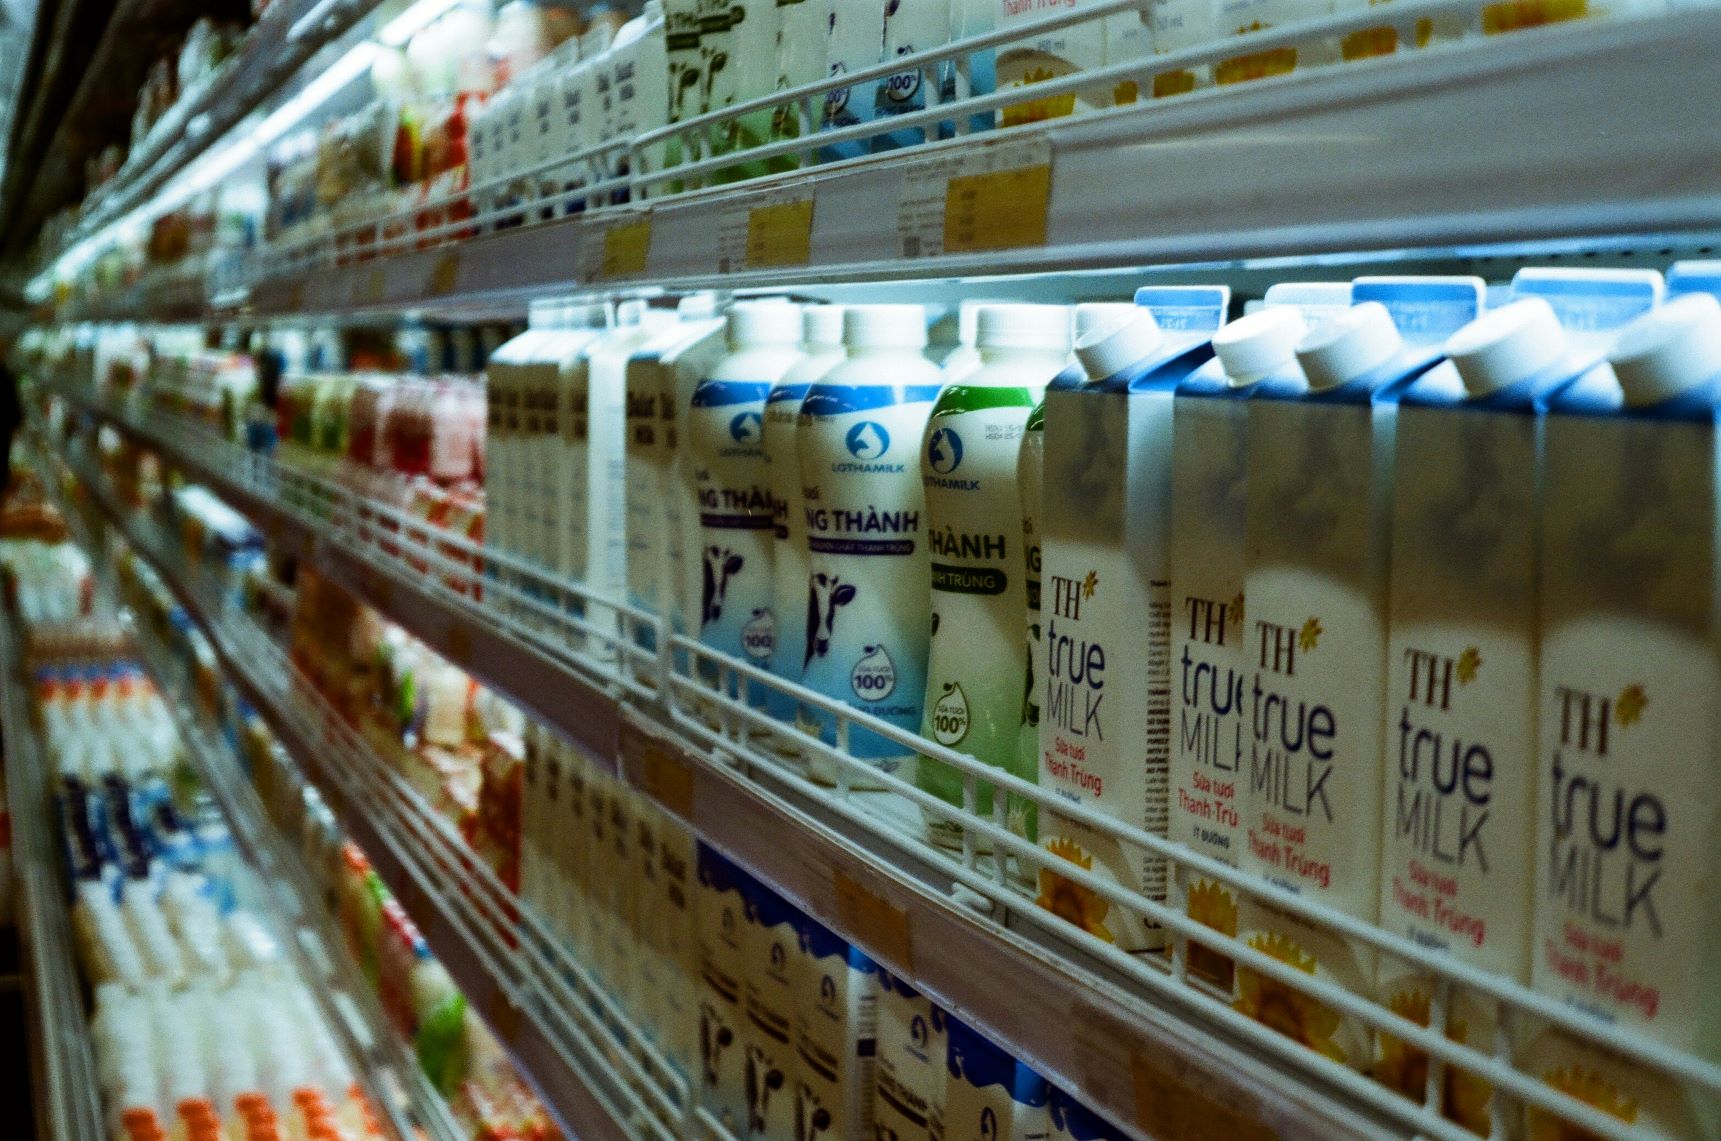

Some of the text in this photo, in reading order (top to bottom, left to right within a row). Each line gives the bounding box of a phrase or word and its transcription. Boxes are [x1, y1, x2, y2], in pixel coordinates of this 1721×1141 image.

[832, 463, 905, 474] LOTHAMILK
[831, 504, 920, 533] THÀNH
[1051, 575, 1081, 622] TH
[1185, 596, 1228, 647] TH
[1047, 619, 1105, 690] true
[1256, 619, 1299, 678] TH
[1404, 647, 1454, 711] TH
[1047, 677, 1103, 742] MILK
[1252, 672, 1336, 762] true
[1554, 684, 1611, 757] TH
[1251, 741, 1334, 824] MILK
[1398, 705, 1494, 807] true
[1178, 787, 1211, 820] Thanh
[1396, 780, 1489, 876] MILK
[1551, 749, 1667, 863] true
[1548, 829, 1662, 940] MILK
